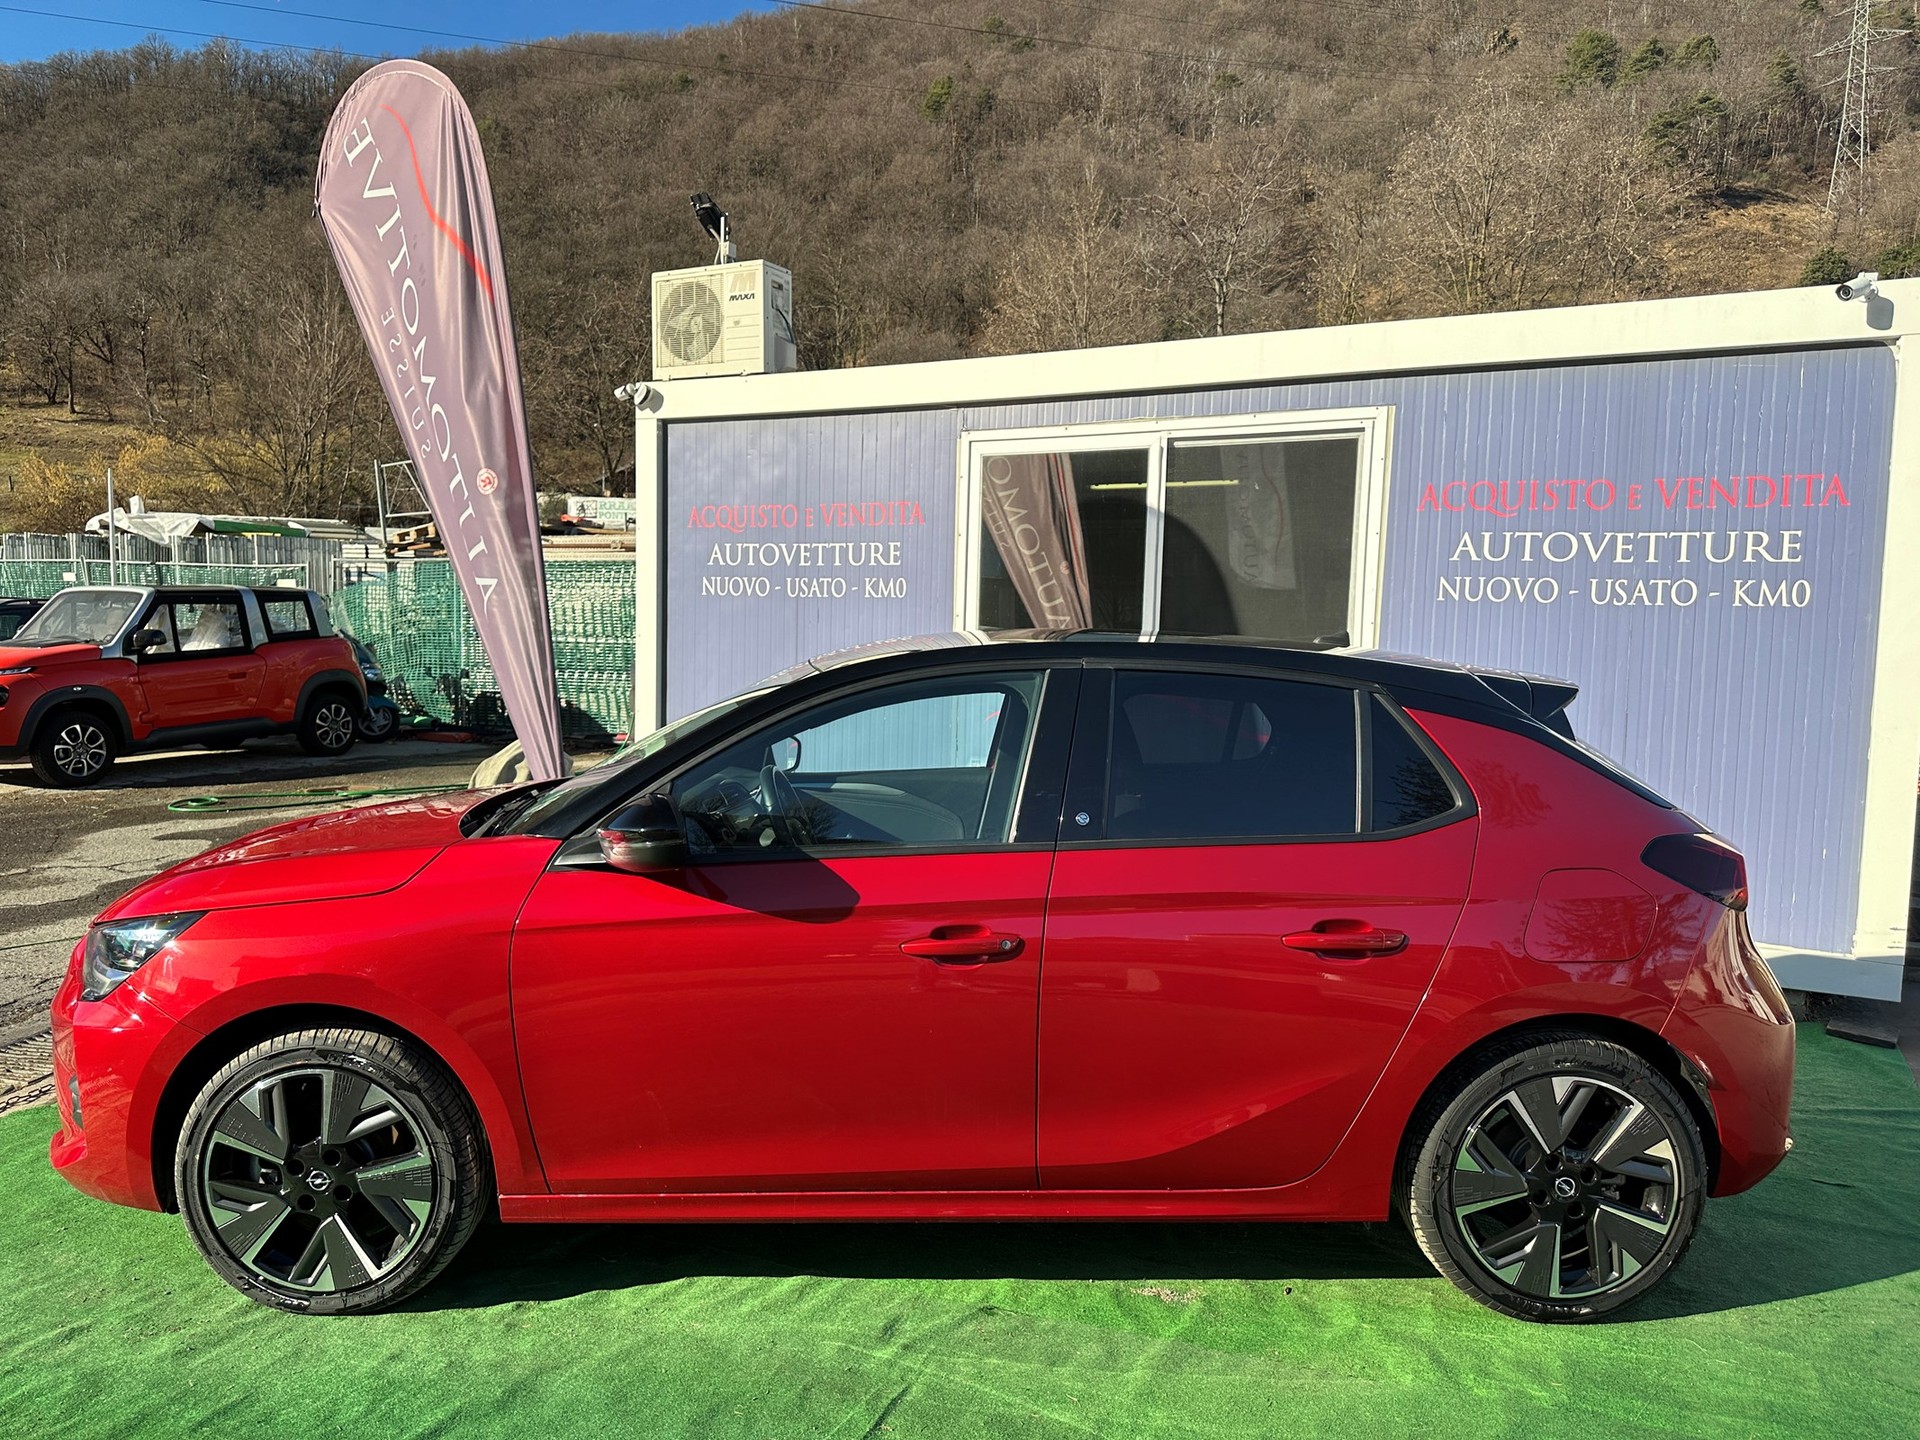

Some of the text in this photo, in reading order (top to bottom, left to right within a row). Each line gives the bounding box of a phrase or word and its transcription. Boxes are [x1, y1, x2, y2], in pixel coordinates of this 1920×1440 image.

[729, 292, 755, 301] MAXA
[1416, 473, 1851, 518] ACQUISTO E VENDITA
[687, 501, 926, 533] ACQUISTO E VENDITA
[707, 542, 901, 567] AUTOVETTURE
[1448, 530, 1803, 564] AUTOVETTURE
[701, 576, 770, 597] NUOVO
[786, 577, 847, 598] USATO
[1437, 576, 1559, 604] NUOVO
[1590, 578, 1698, 607] USATO
